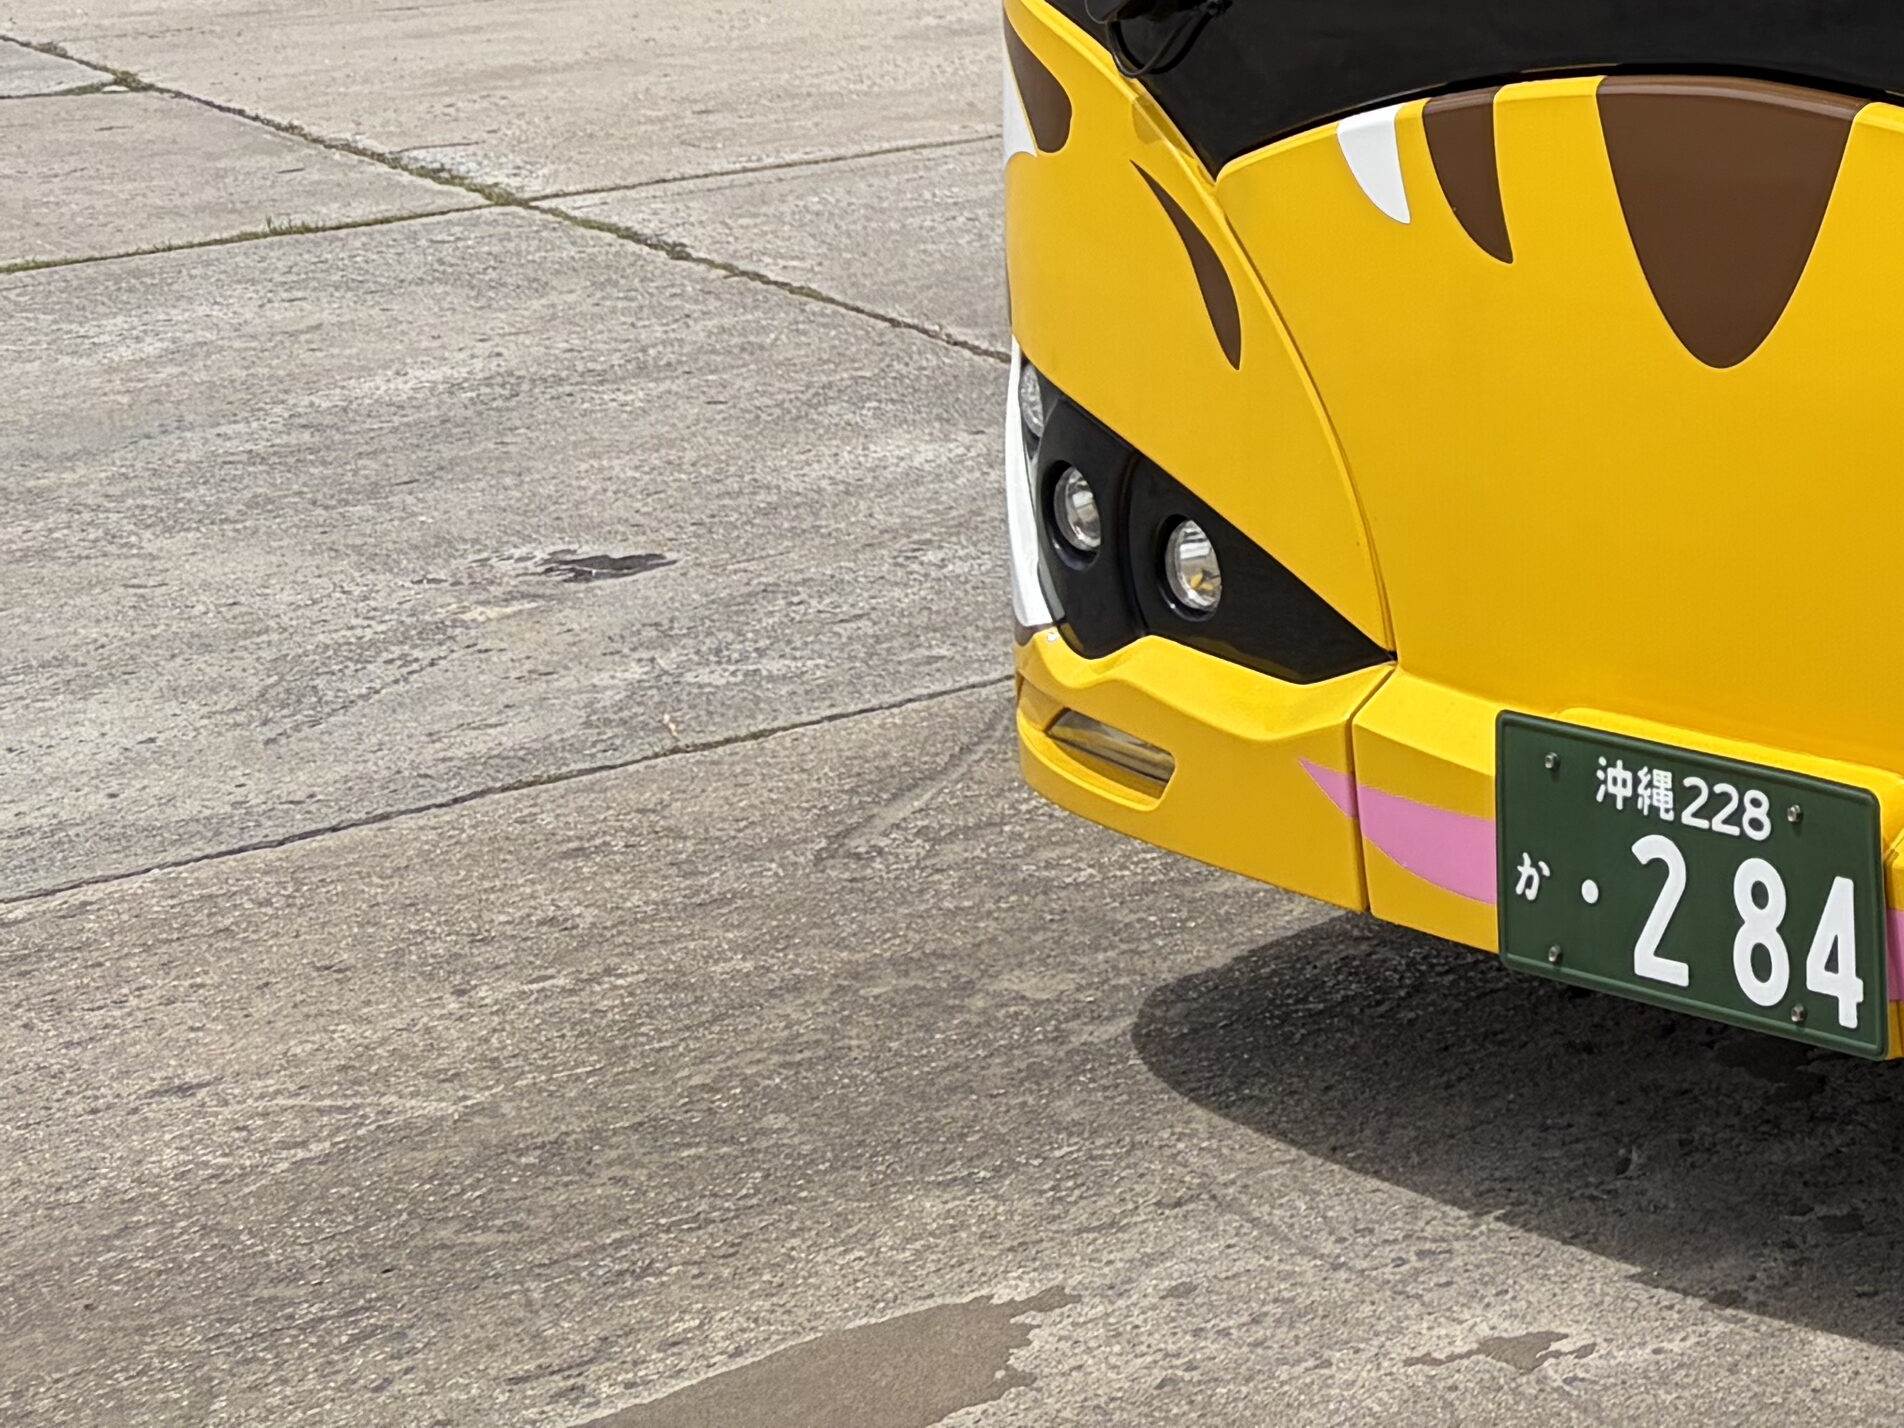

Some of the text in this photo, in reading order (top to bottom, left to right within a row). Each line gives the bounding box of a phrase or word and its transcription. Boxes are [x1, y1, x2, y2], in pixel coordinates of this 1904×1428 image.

[1595, 755, 1773, 842] 沖縄 228
[1514, 851, 1551, 903] か
